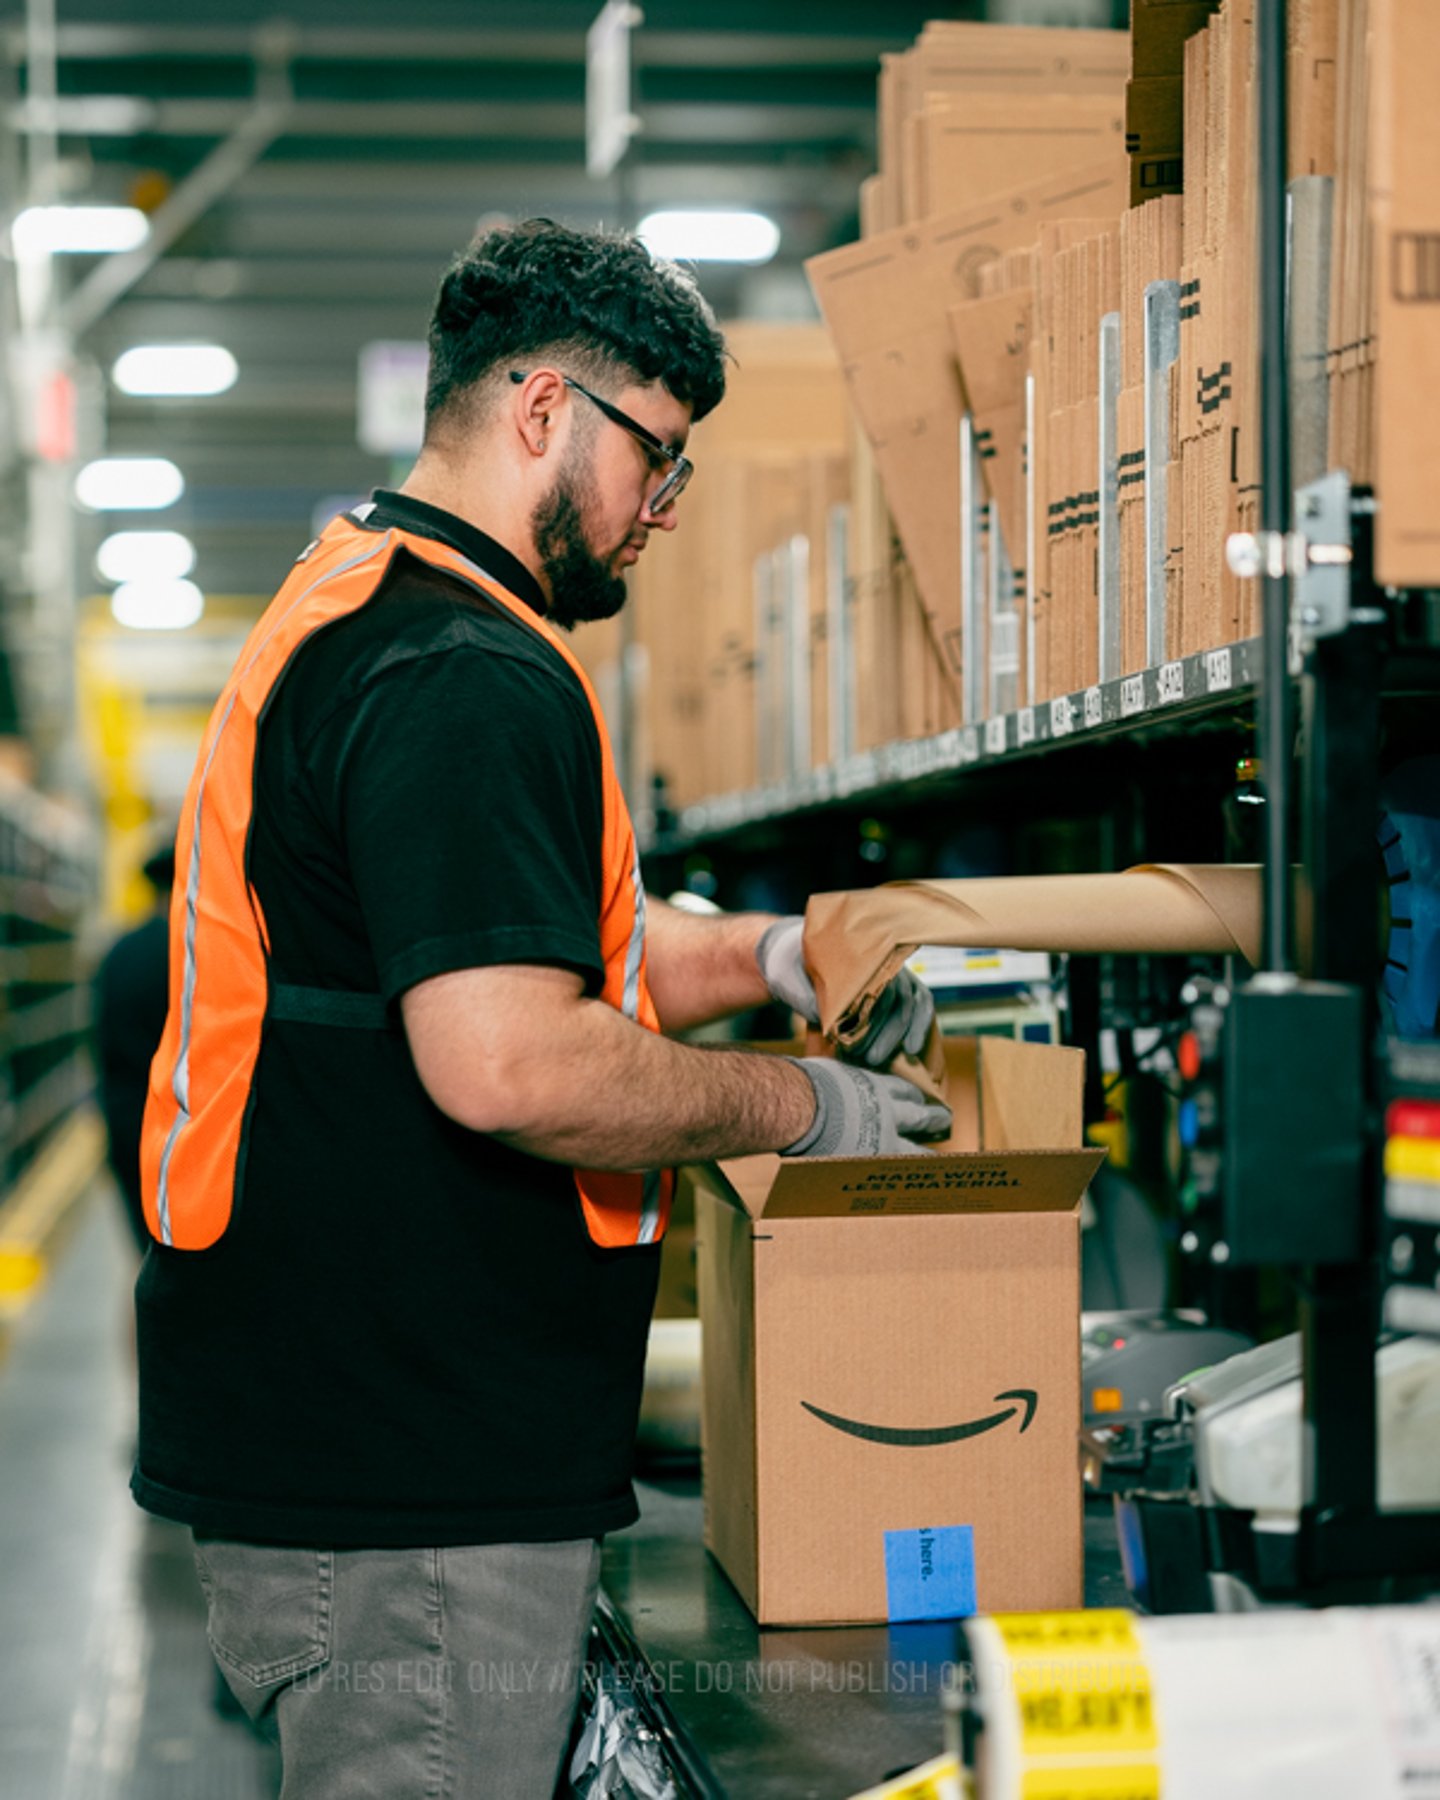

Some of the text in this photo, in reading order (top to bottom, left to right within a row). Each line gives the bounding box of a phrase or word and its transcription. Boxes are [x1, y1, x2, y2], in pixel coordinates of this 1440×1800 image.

[866, 1169, 1008, 1182] MADE WITH
[841, 1178, 1022, 1192] LESS MATERIAL
[920, 1538, 935, 1581] here.
